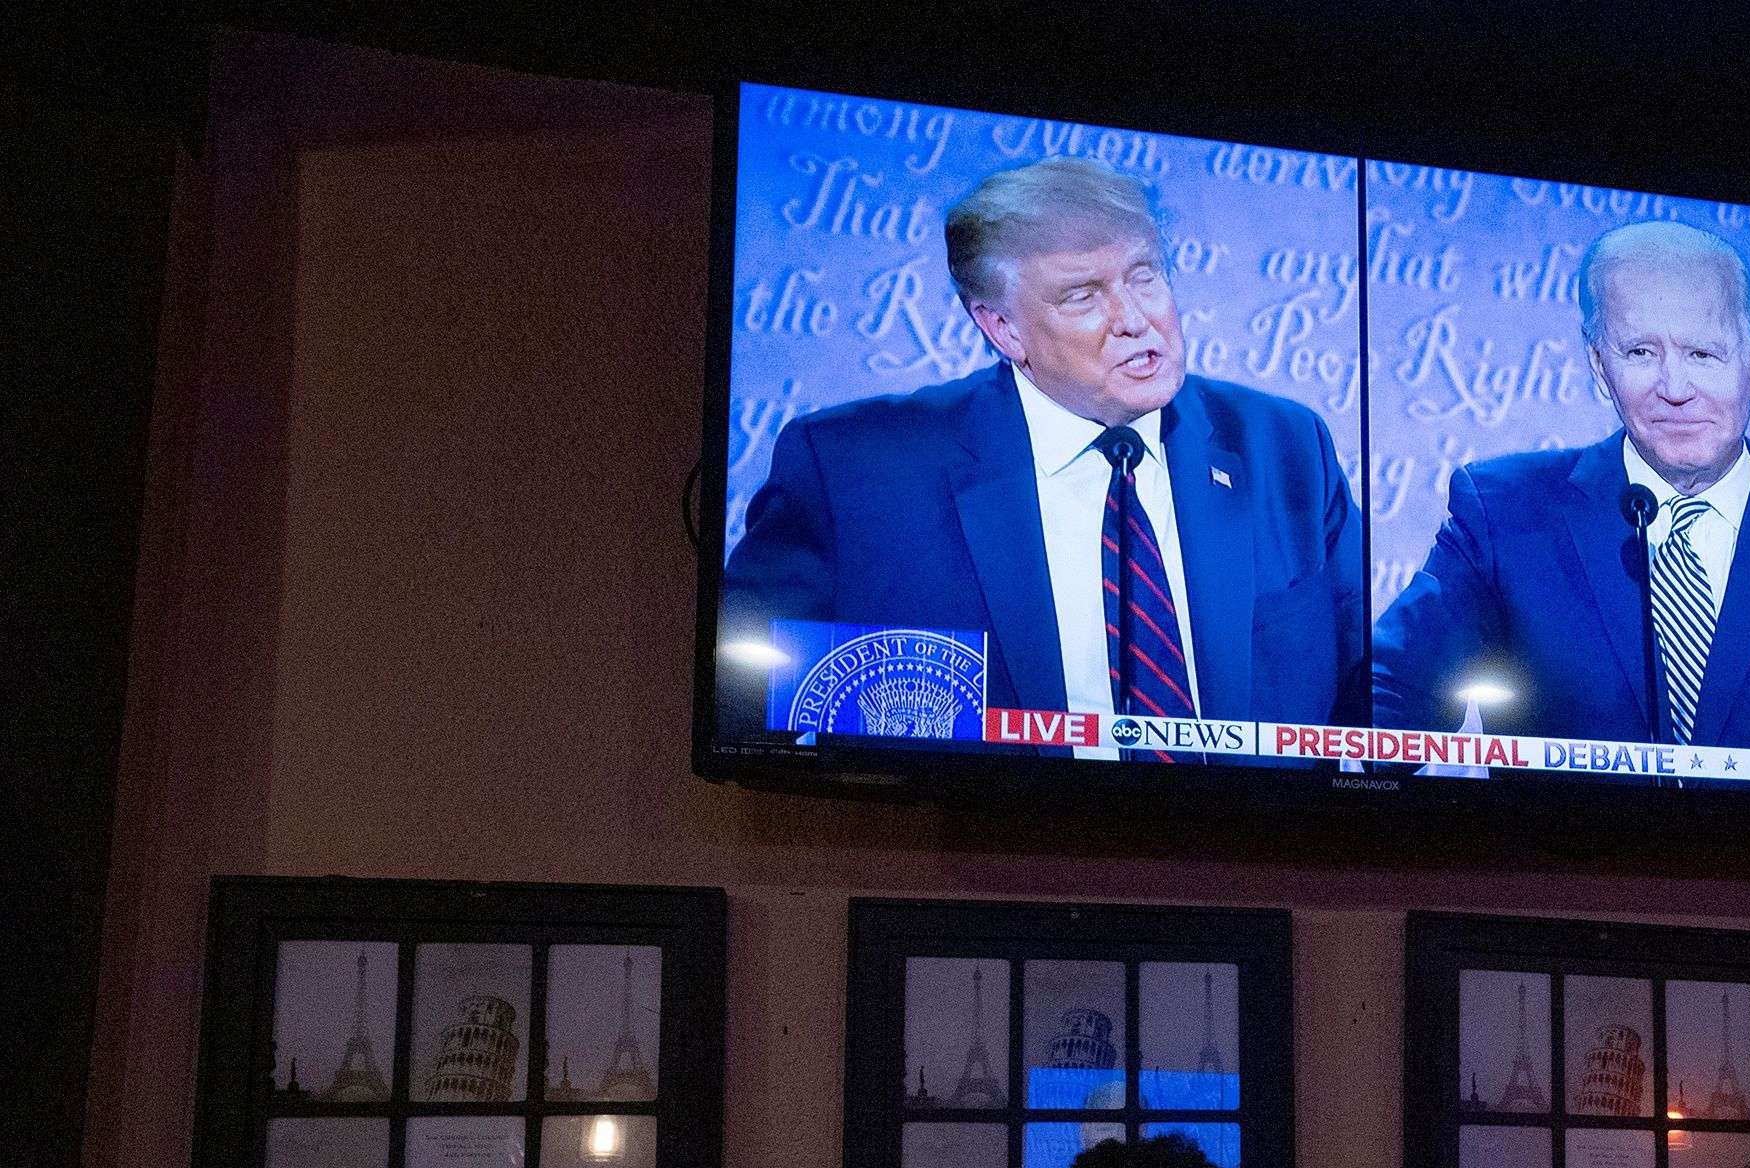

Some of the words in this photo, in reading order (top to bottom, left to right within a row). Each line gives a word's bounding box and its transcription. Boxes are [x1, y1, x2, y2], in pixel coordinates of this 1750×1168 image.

[782, 152, 934, 243] That
[745, 266, 839, 337] the
[1396, 303, 1578, 425] Right
[799, 637, 909, 728] PRESIDENT
[914, 641, 938, 657] OF
[942, 649, 972, 673] THE
[1000, 711, 1086, 744] LIVE
[1111, 723, 1142, 738] abc
[1144, 720, 1244, 750] NEWS
[1276, 725, 1529, 767] PRESIDENTIAL
[1543, 741, 1676, 774] DEBATE
[1332, 777, 1400, 791] MAGNAVOX
